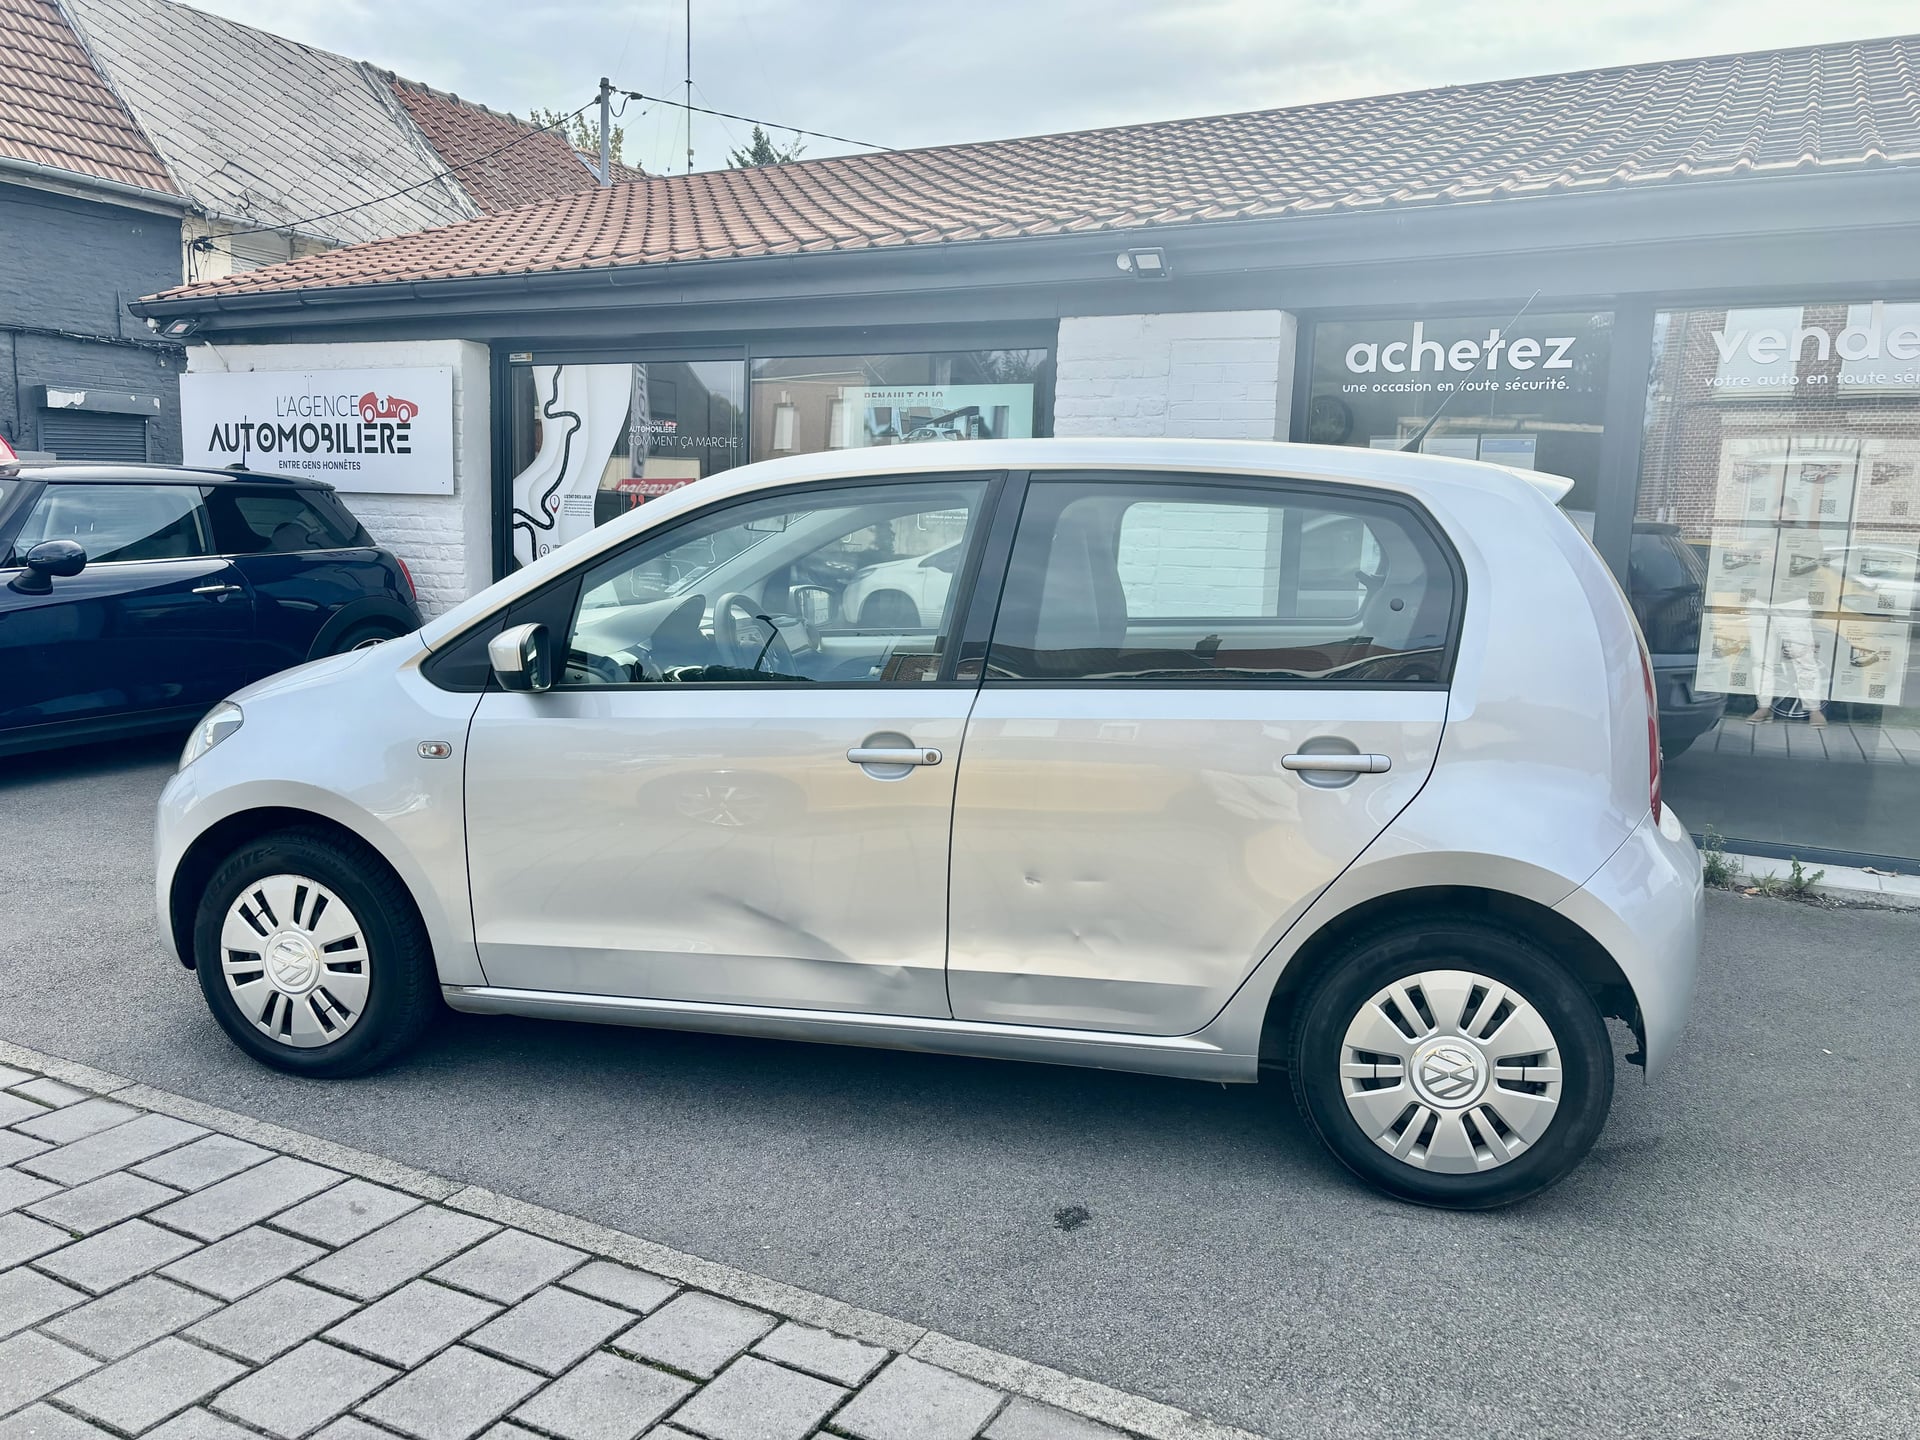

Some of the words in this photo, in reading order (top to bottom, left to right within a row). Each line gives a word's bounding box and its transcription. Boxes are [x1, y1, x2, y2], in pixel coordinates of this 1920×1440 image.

[1345, 321, 1577, 373] achetez
[1342, 382, 1367, 393] une
[1372, 379, 1431, 392] occasion
[1437, 381, 1454, 392] en
[1460, 379, 1500, 392] toute
[1504, 375, 1570, 391] sécurité.
[1705, 374, 1750, 387] votre
[1757, 373, 1799, 386] auto
[1806, 374, 1828, 385] en
[1836, 371, 1886, 385] toute
[276, 395, 359, 417] L'AGENCE
[628, 435, 678, 447] COMMENT
[680, 436, 694, 449] ÇA
[696, 436, 738, 448] MARCHE
[278, 460, 300, 470] ENTRE
[302, 460, 321, 470] GENS
[322, 459, 361, 470] HONNÊTES
